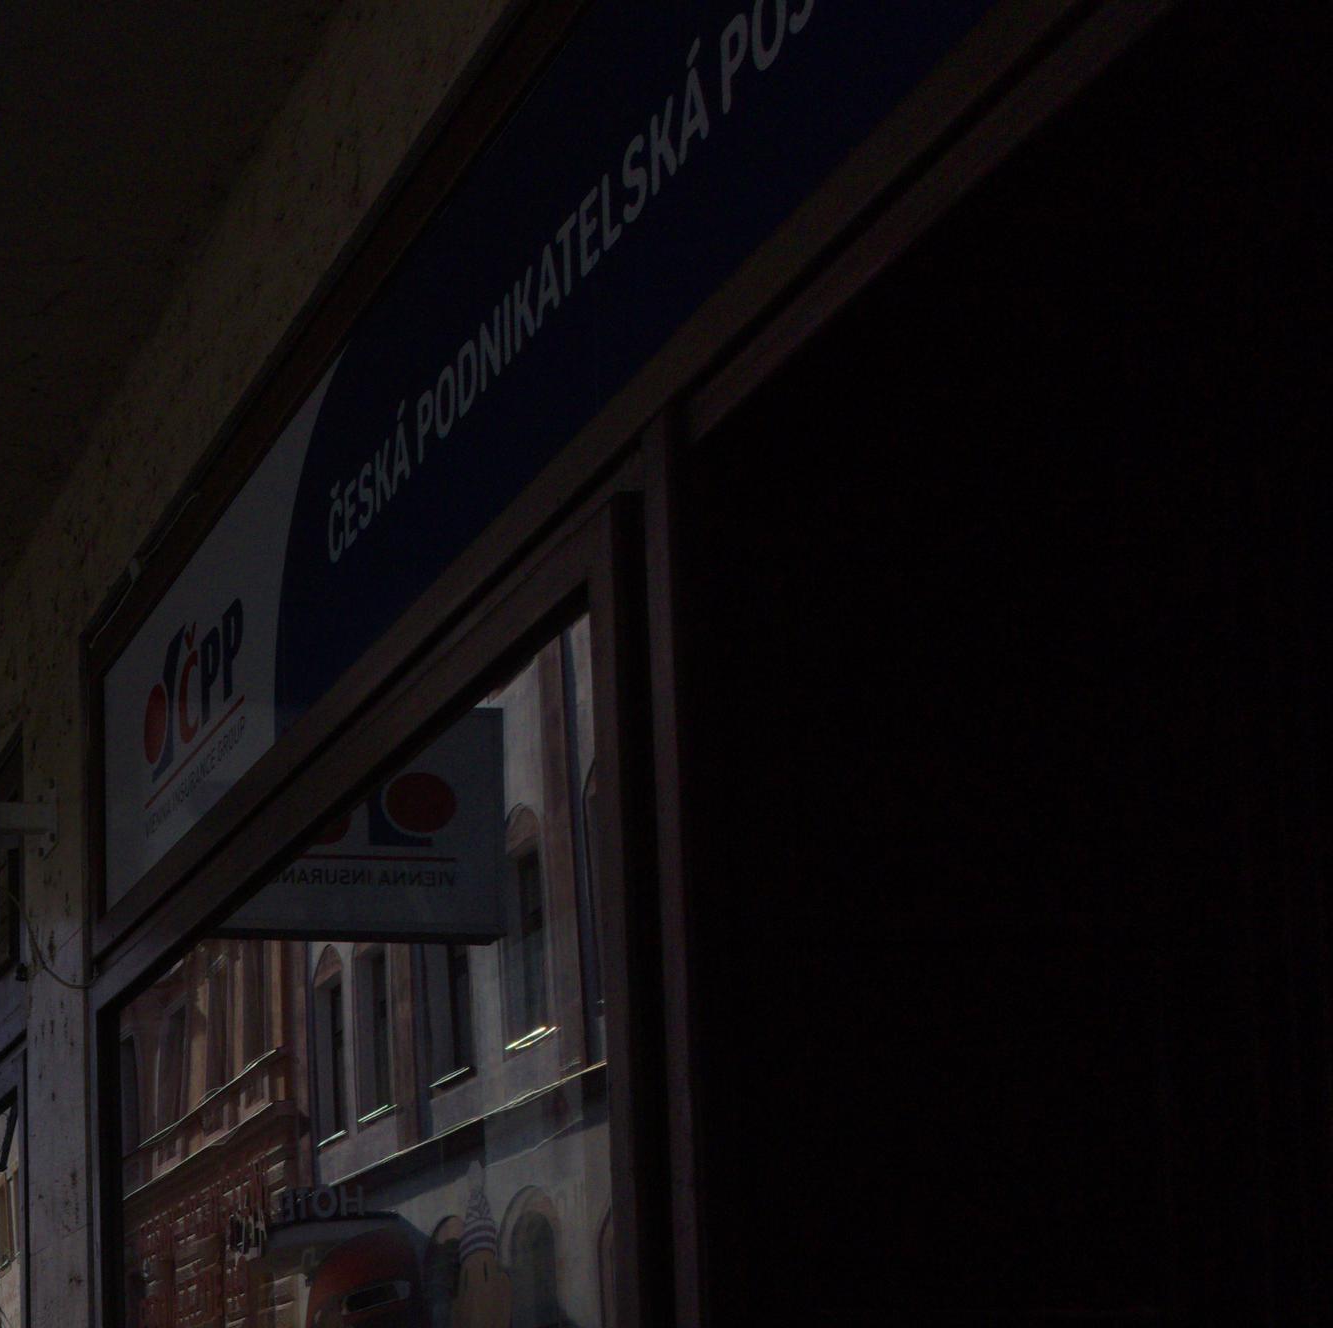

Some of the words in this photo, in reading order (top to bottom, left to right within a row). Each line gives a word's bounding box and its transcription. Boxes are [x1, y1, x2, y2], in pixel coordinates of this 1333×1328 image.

[326, 398, 411, 564] ČESKÁ
[416, 36, 710, 465] PODNIKATELSKÁ
[178, 597, 244, 745] ČPP
